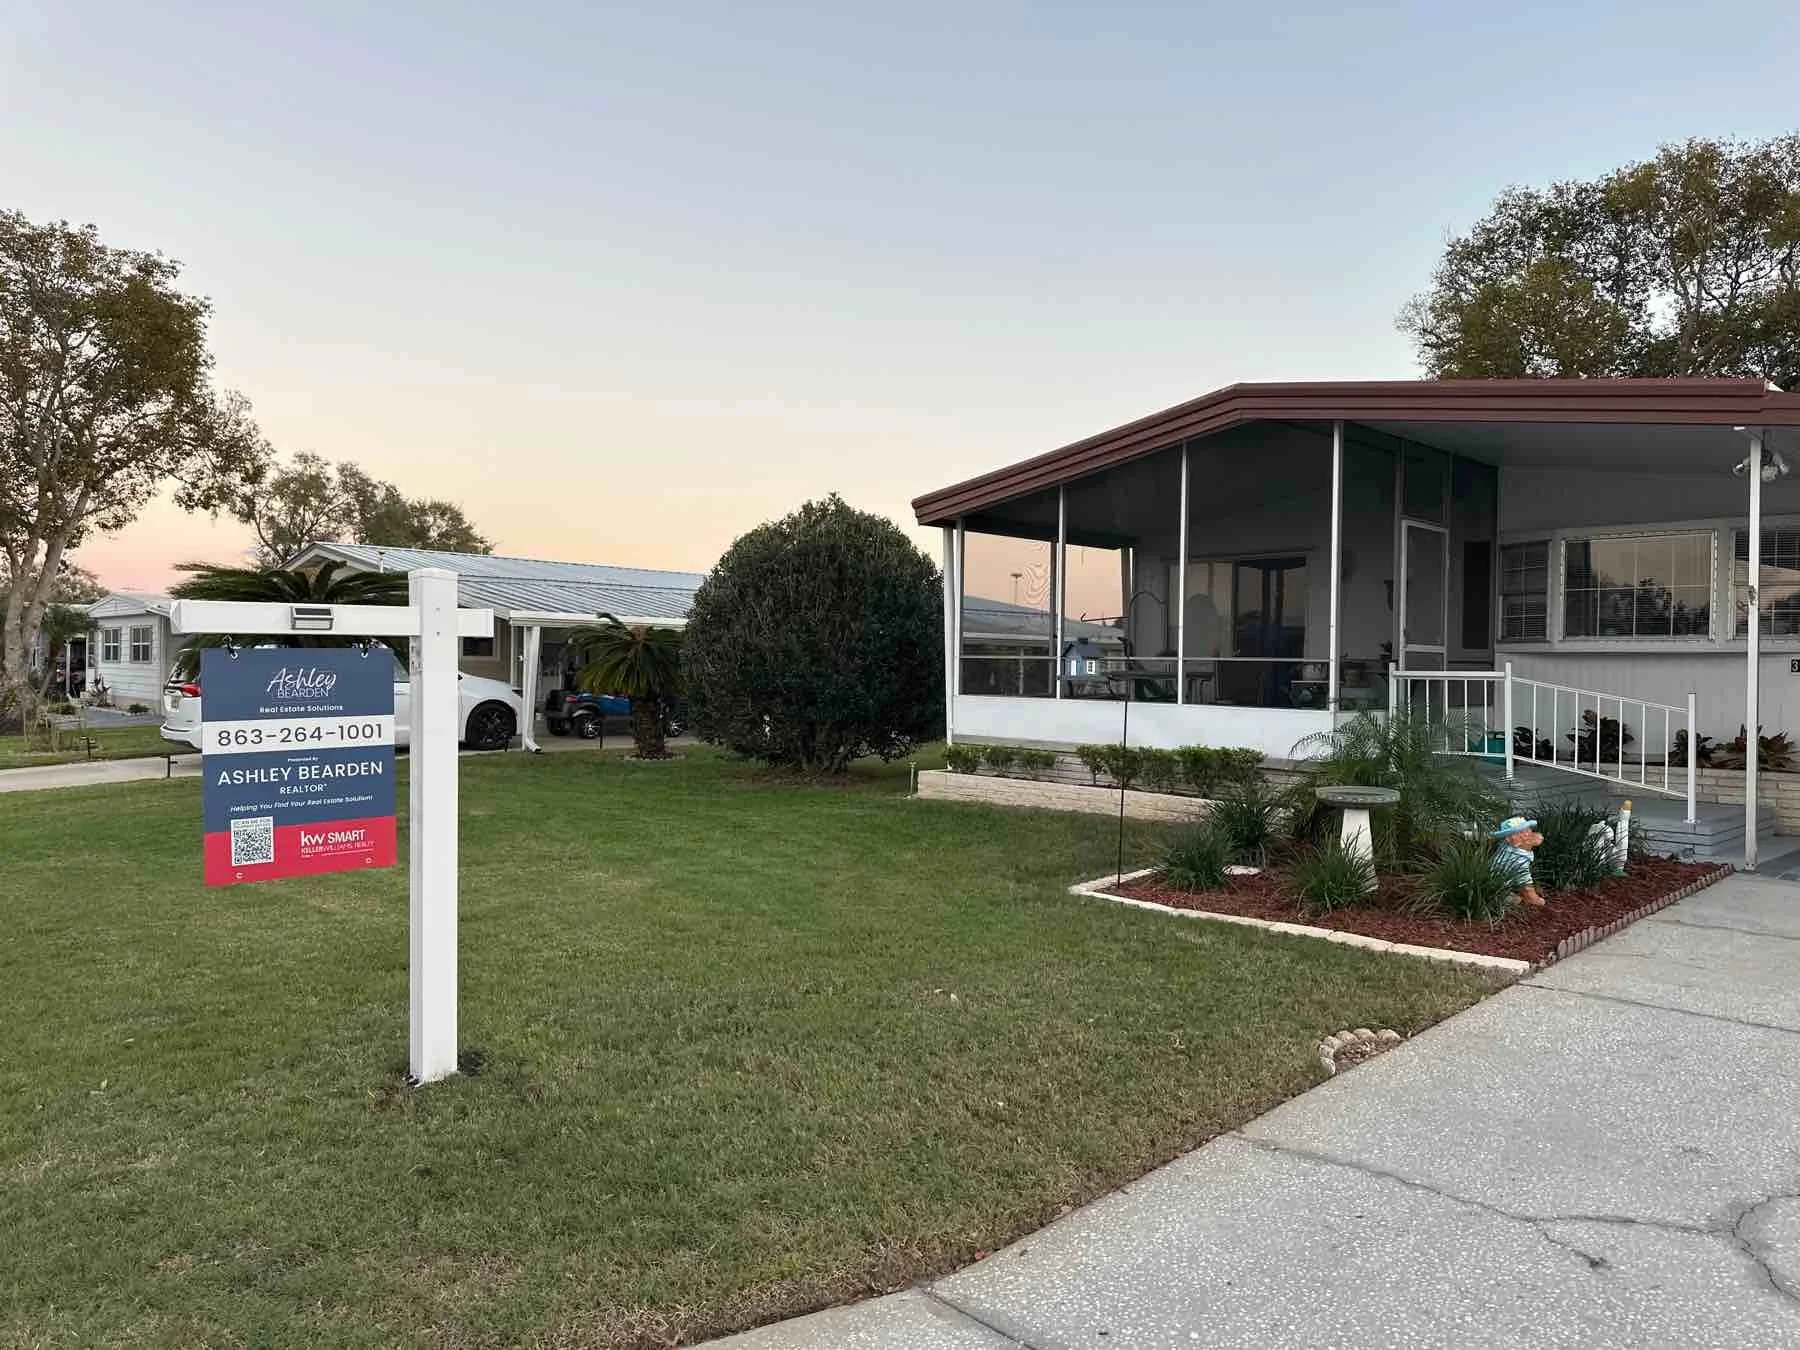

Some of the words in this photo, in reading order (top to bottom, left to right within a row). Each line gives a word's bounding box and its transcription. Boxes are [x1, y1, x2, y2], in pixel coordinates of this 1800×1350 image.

[267, 667, 337, 692] Ashley
[277, 687, 329, 698] BEARDEN
[218, 723, 383, 747] 863-264-1001
[217, 767, 292, 786] ASHLEY
[299, 761, 383, 780] BEARDEN
[300, 830, 326, 847] kw
[328, 829, 367, 844] SMART
